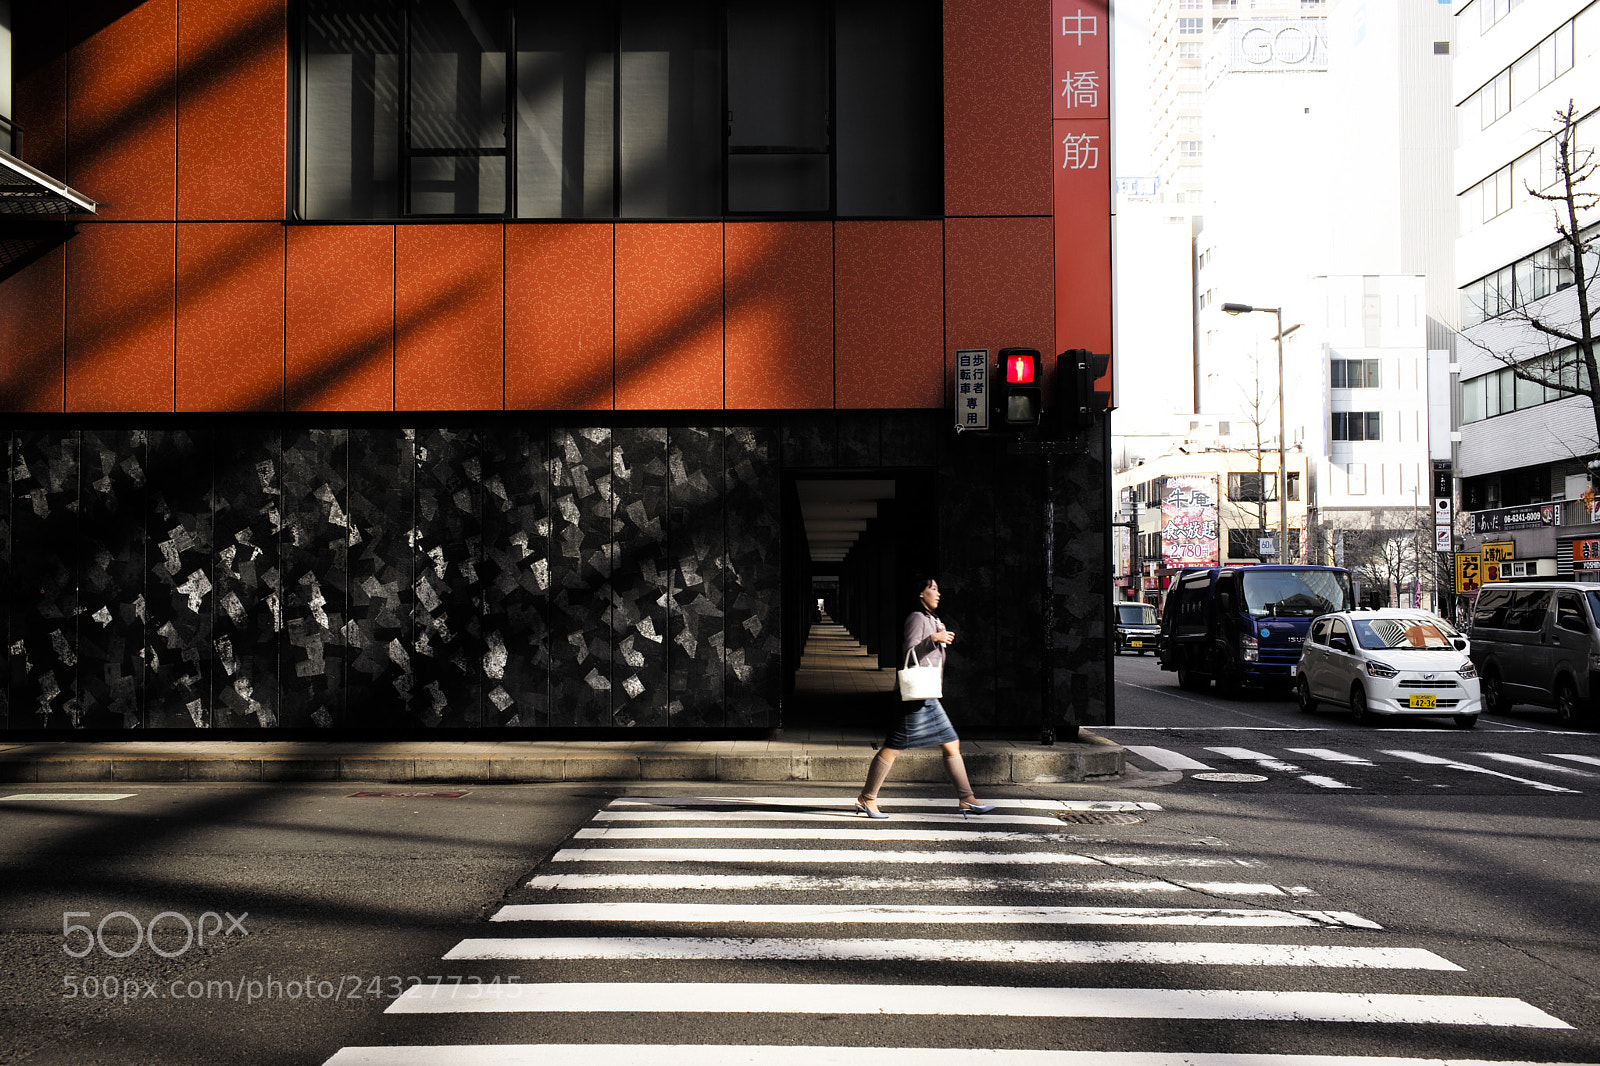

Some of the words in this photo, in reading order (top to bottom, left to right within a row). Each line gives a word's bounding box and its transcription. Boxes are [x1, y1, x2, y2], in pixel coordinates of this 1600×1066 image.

[1061, 9, 1099, 170] 中橋筋
[959, 354, 971, 395] 自転車
[972, 354, 985, 394] 歩行者
[966, 397, 978, 424] 専用
[1163, 520, 1218, 540] 食べ放題
[1503, 511, 1541, 524] 06-6241-6009
[1415, 699, 1436, 707] 42-36
